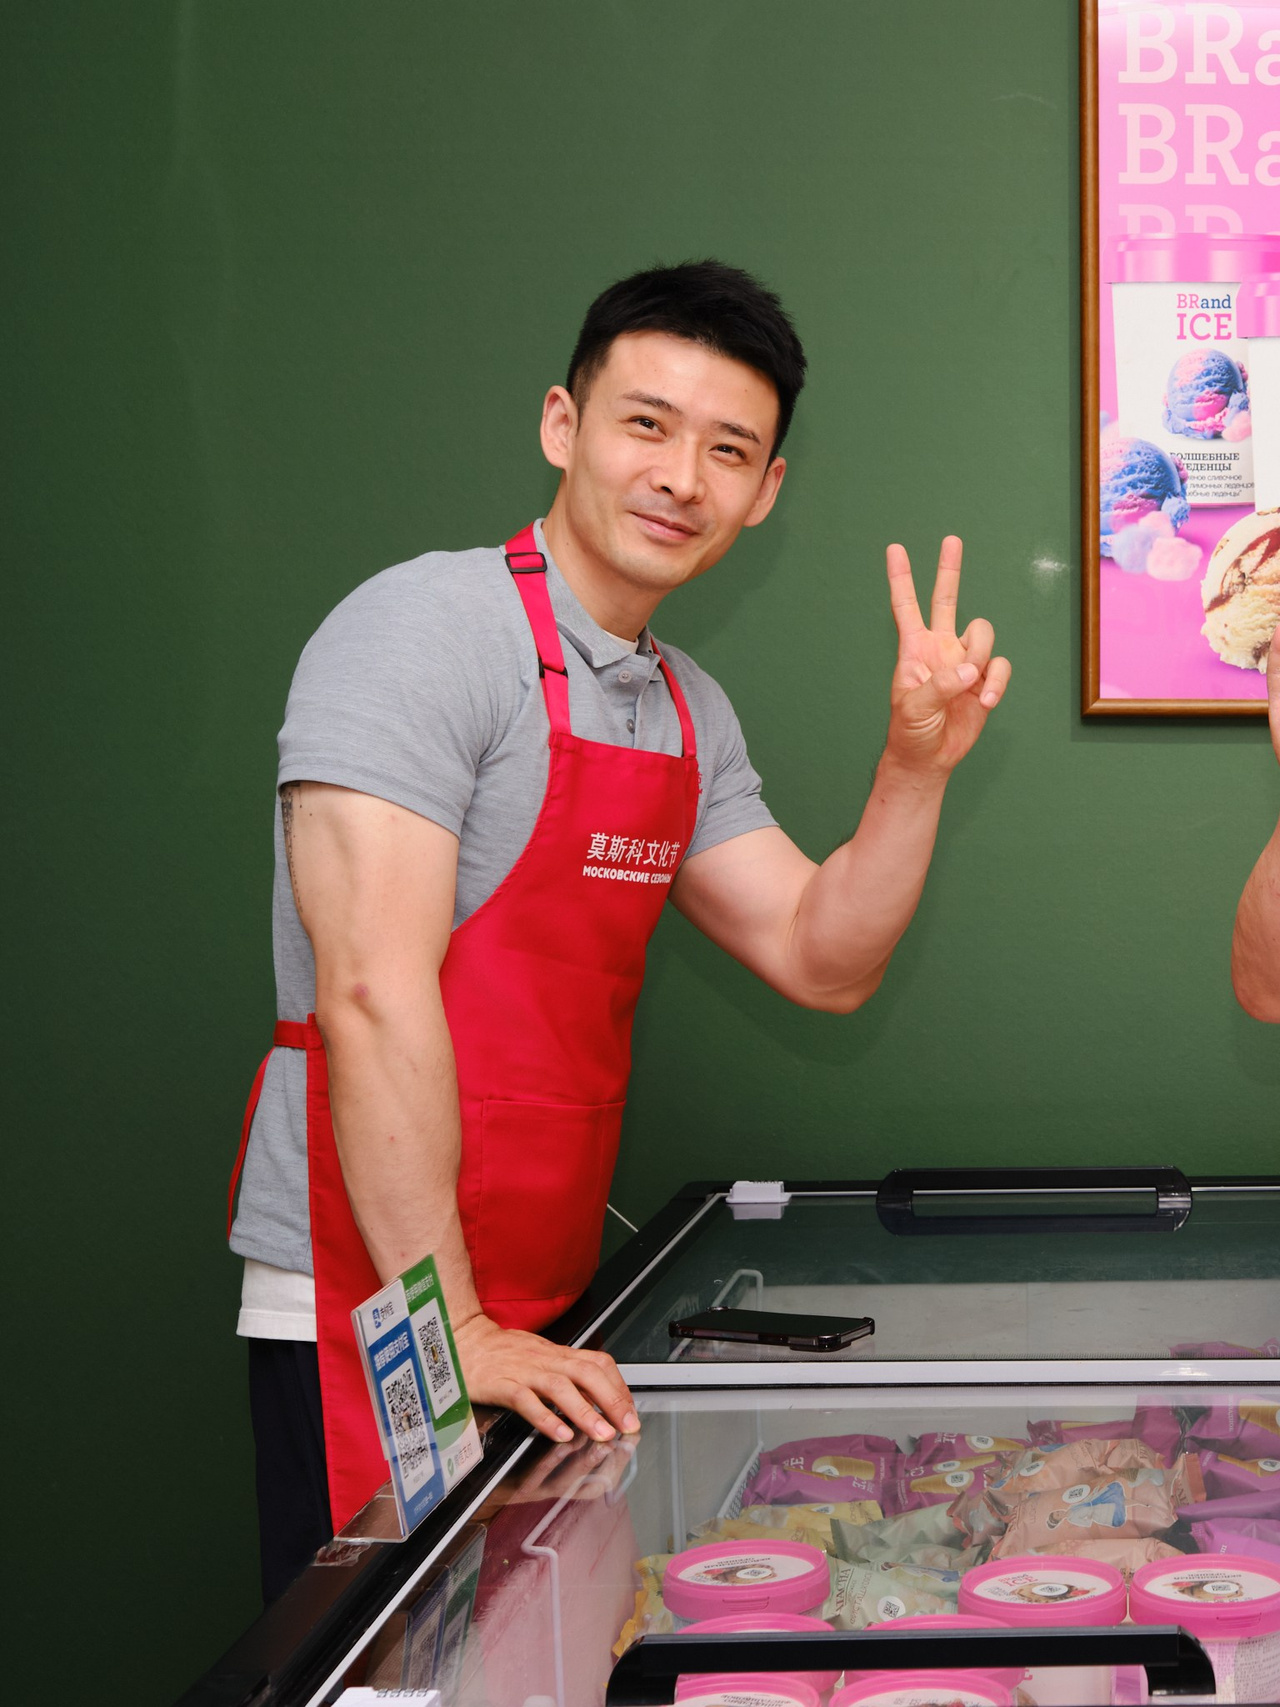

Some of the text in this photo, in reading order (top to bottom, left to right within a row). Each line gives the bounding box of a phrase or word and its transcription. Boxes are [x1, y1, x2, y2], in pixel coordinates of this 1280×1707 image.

[1176, 293, 1232, 309] BRand
[1176, 313, 1232, 340] ICE
[1183, 463, 1232, 472] ЕДЕНЦЫ
[586, 832, 680, 868] 莫斯科文化节
[582, 865, 649, 884] МОСКОВСКИЕ
